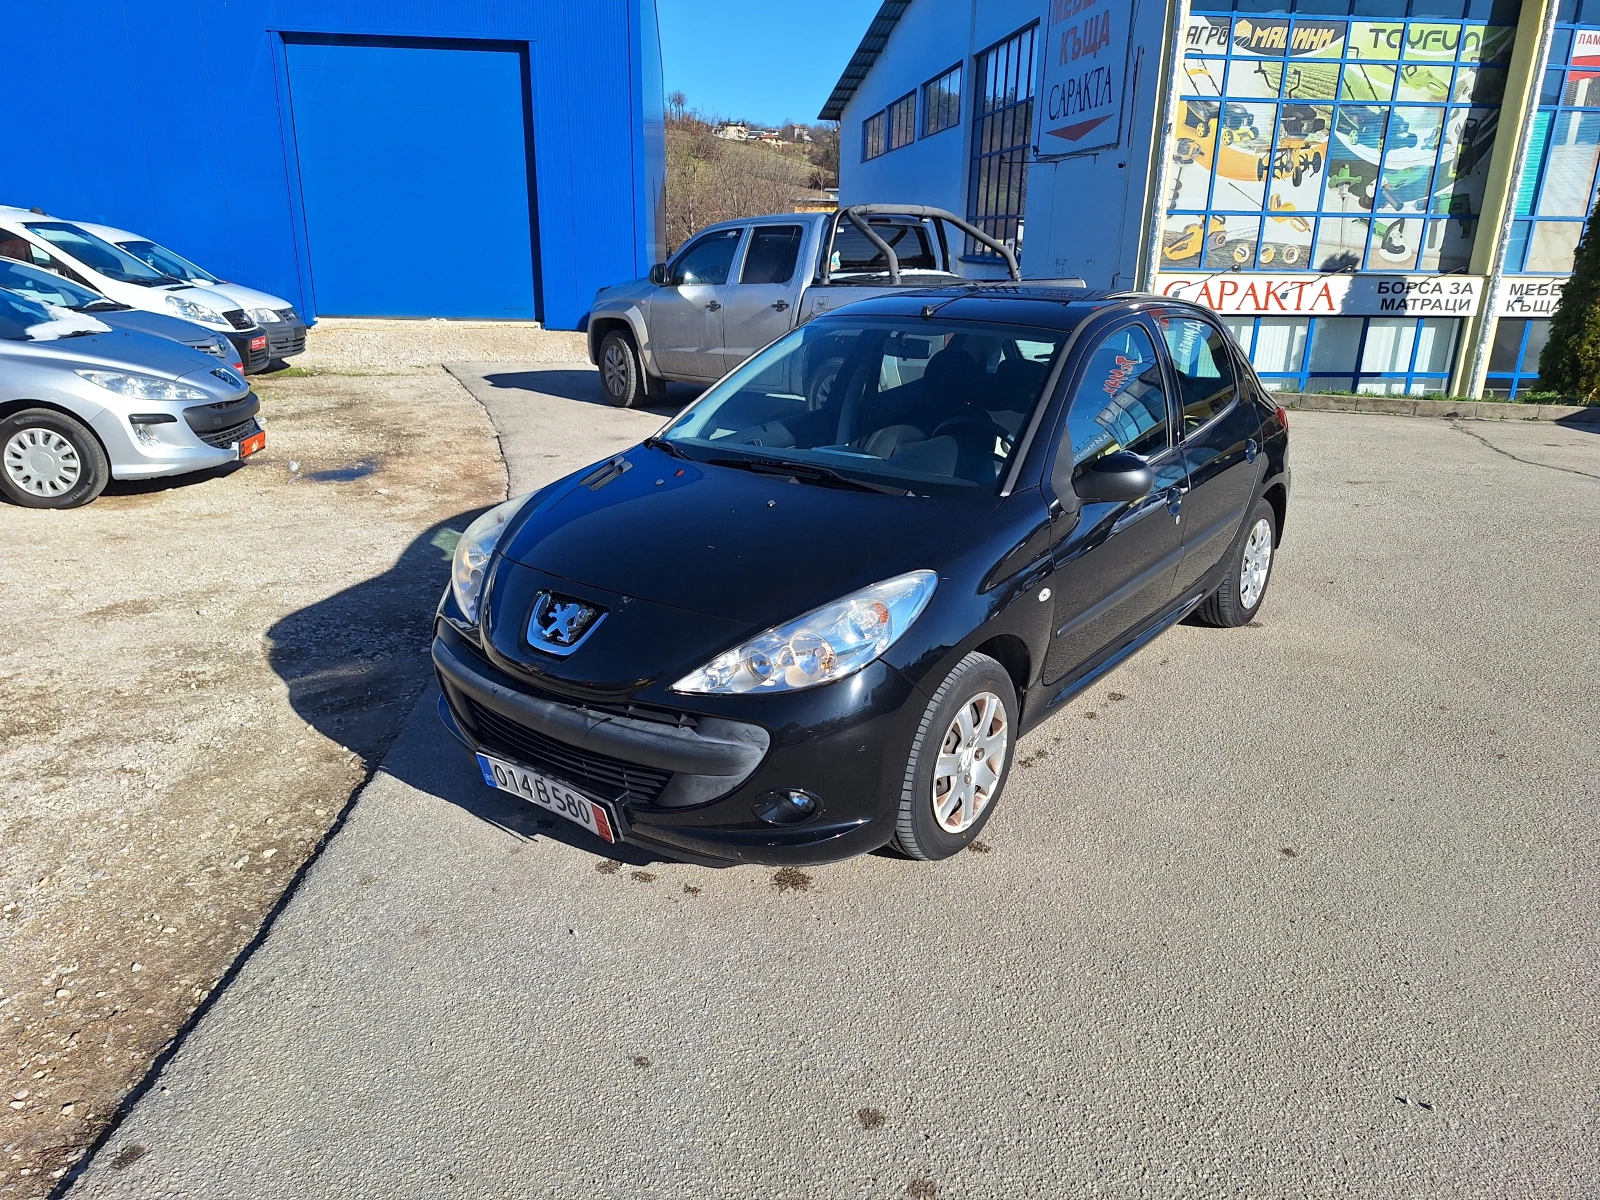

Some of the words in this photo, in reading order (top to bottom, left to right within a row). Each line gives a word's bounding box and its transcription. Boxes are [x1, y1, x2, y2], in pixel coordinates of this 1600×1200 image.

[1059, 9, 1110, 67] КЪЩА
[1186, 25, 1230, 46] АГРО
[1251, 25, 1335, 50] МАШИНИ
[1048, 64, 1112, 121] САРАКТА
[1377, 281, 1443, 295] БОРСА
[1449, 282, 1474, 295] ЗА
[1380, 298, 1471, 313] МАТРАЦИ
[1505, 299, 1563, 314] КЪЩА
[494, 764, 590, 825] 014B580
